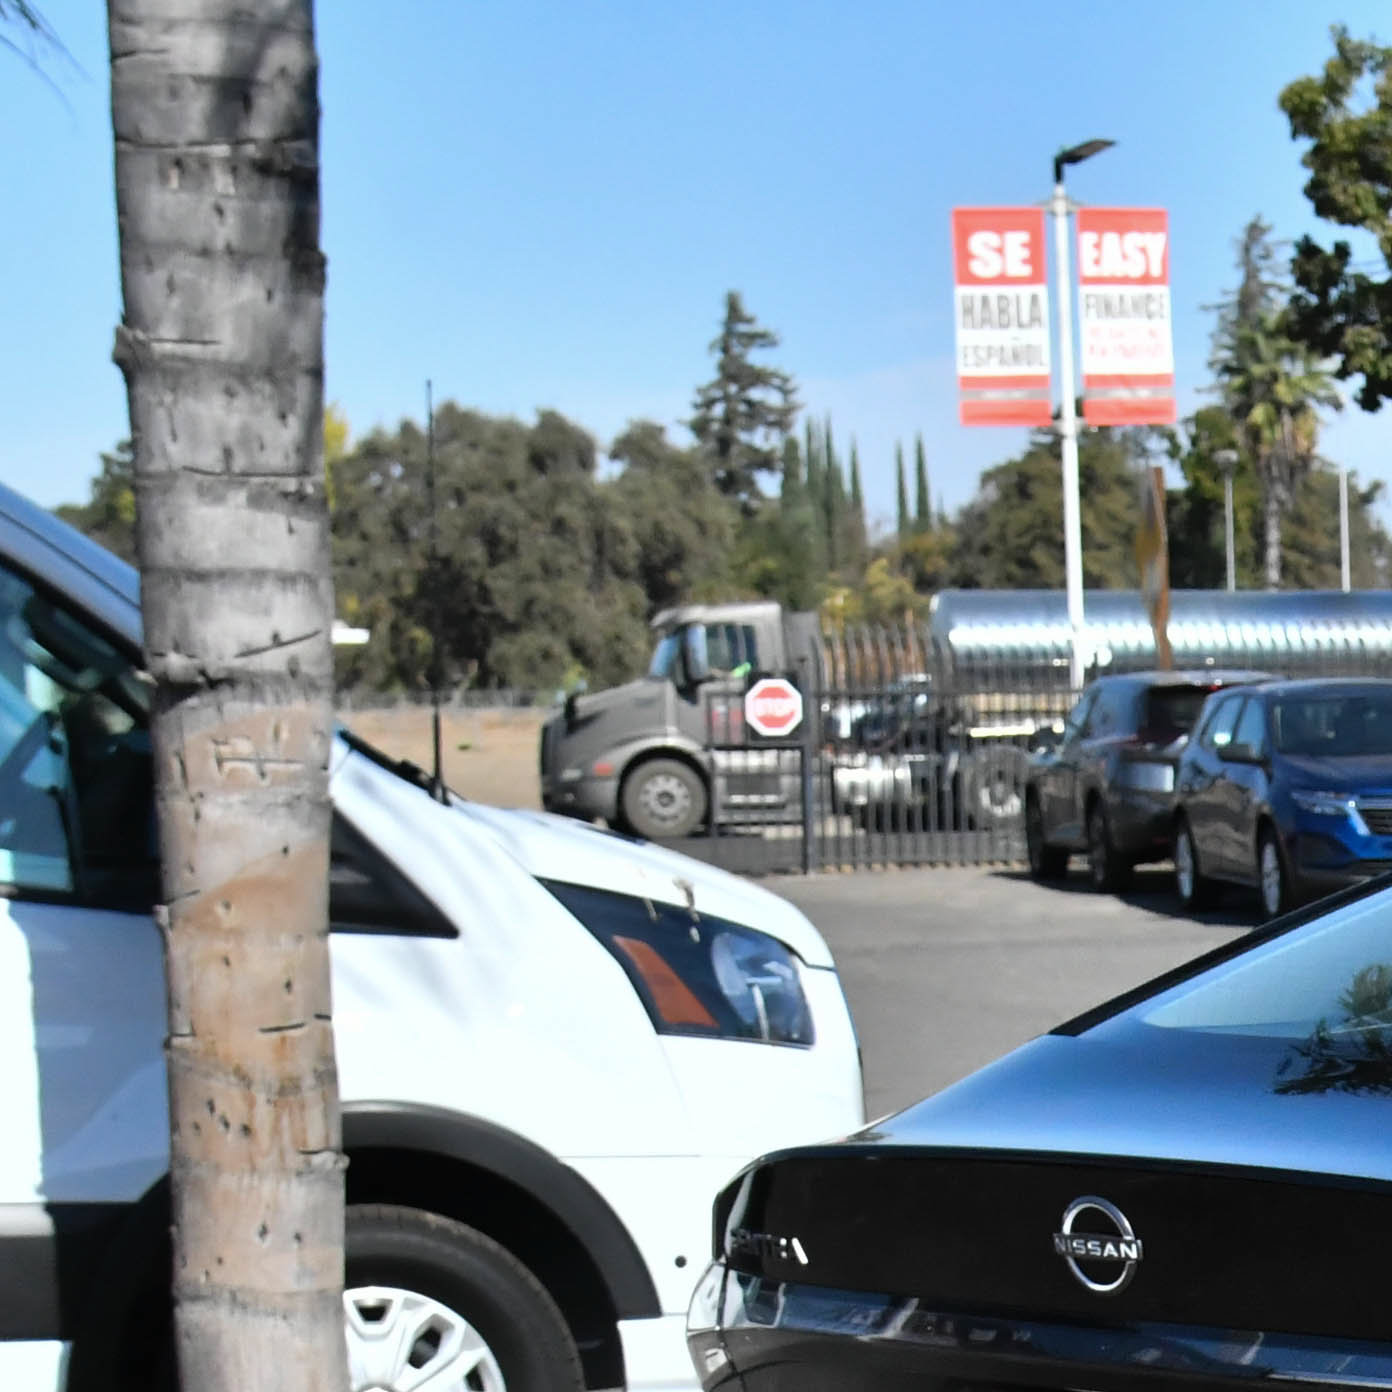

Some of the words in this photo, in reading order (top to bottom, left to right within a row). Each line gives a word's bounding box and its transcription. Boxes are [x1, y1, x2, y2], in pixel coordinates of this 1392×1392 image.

[968, 231, 1032, 278] SE
[1079, 231, 1167, 278] EASY
[962, 294, 1042, 329] HABLA
[1054, 1237, 1139, 1260] NISSAN
